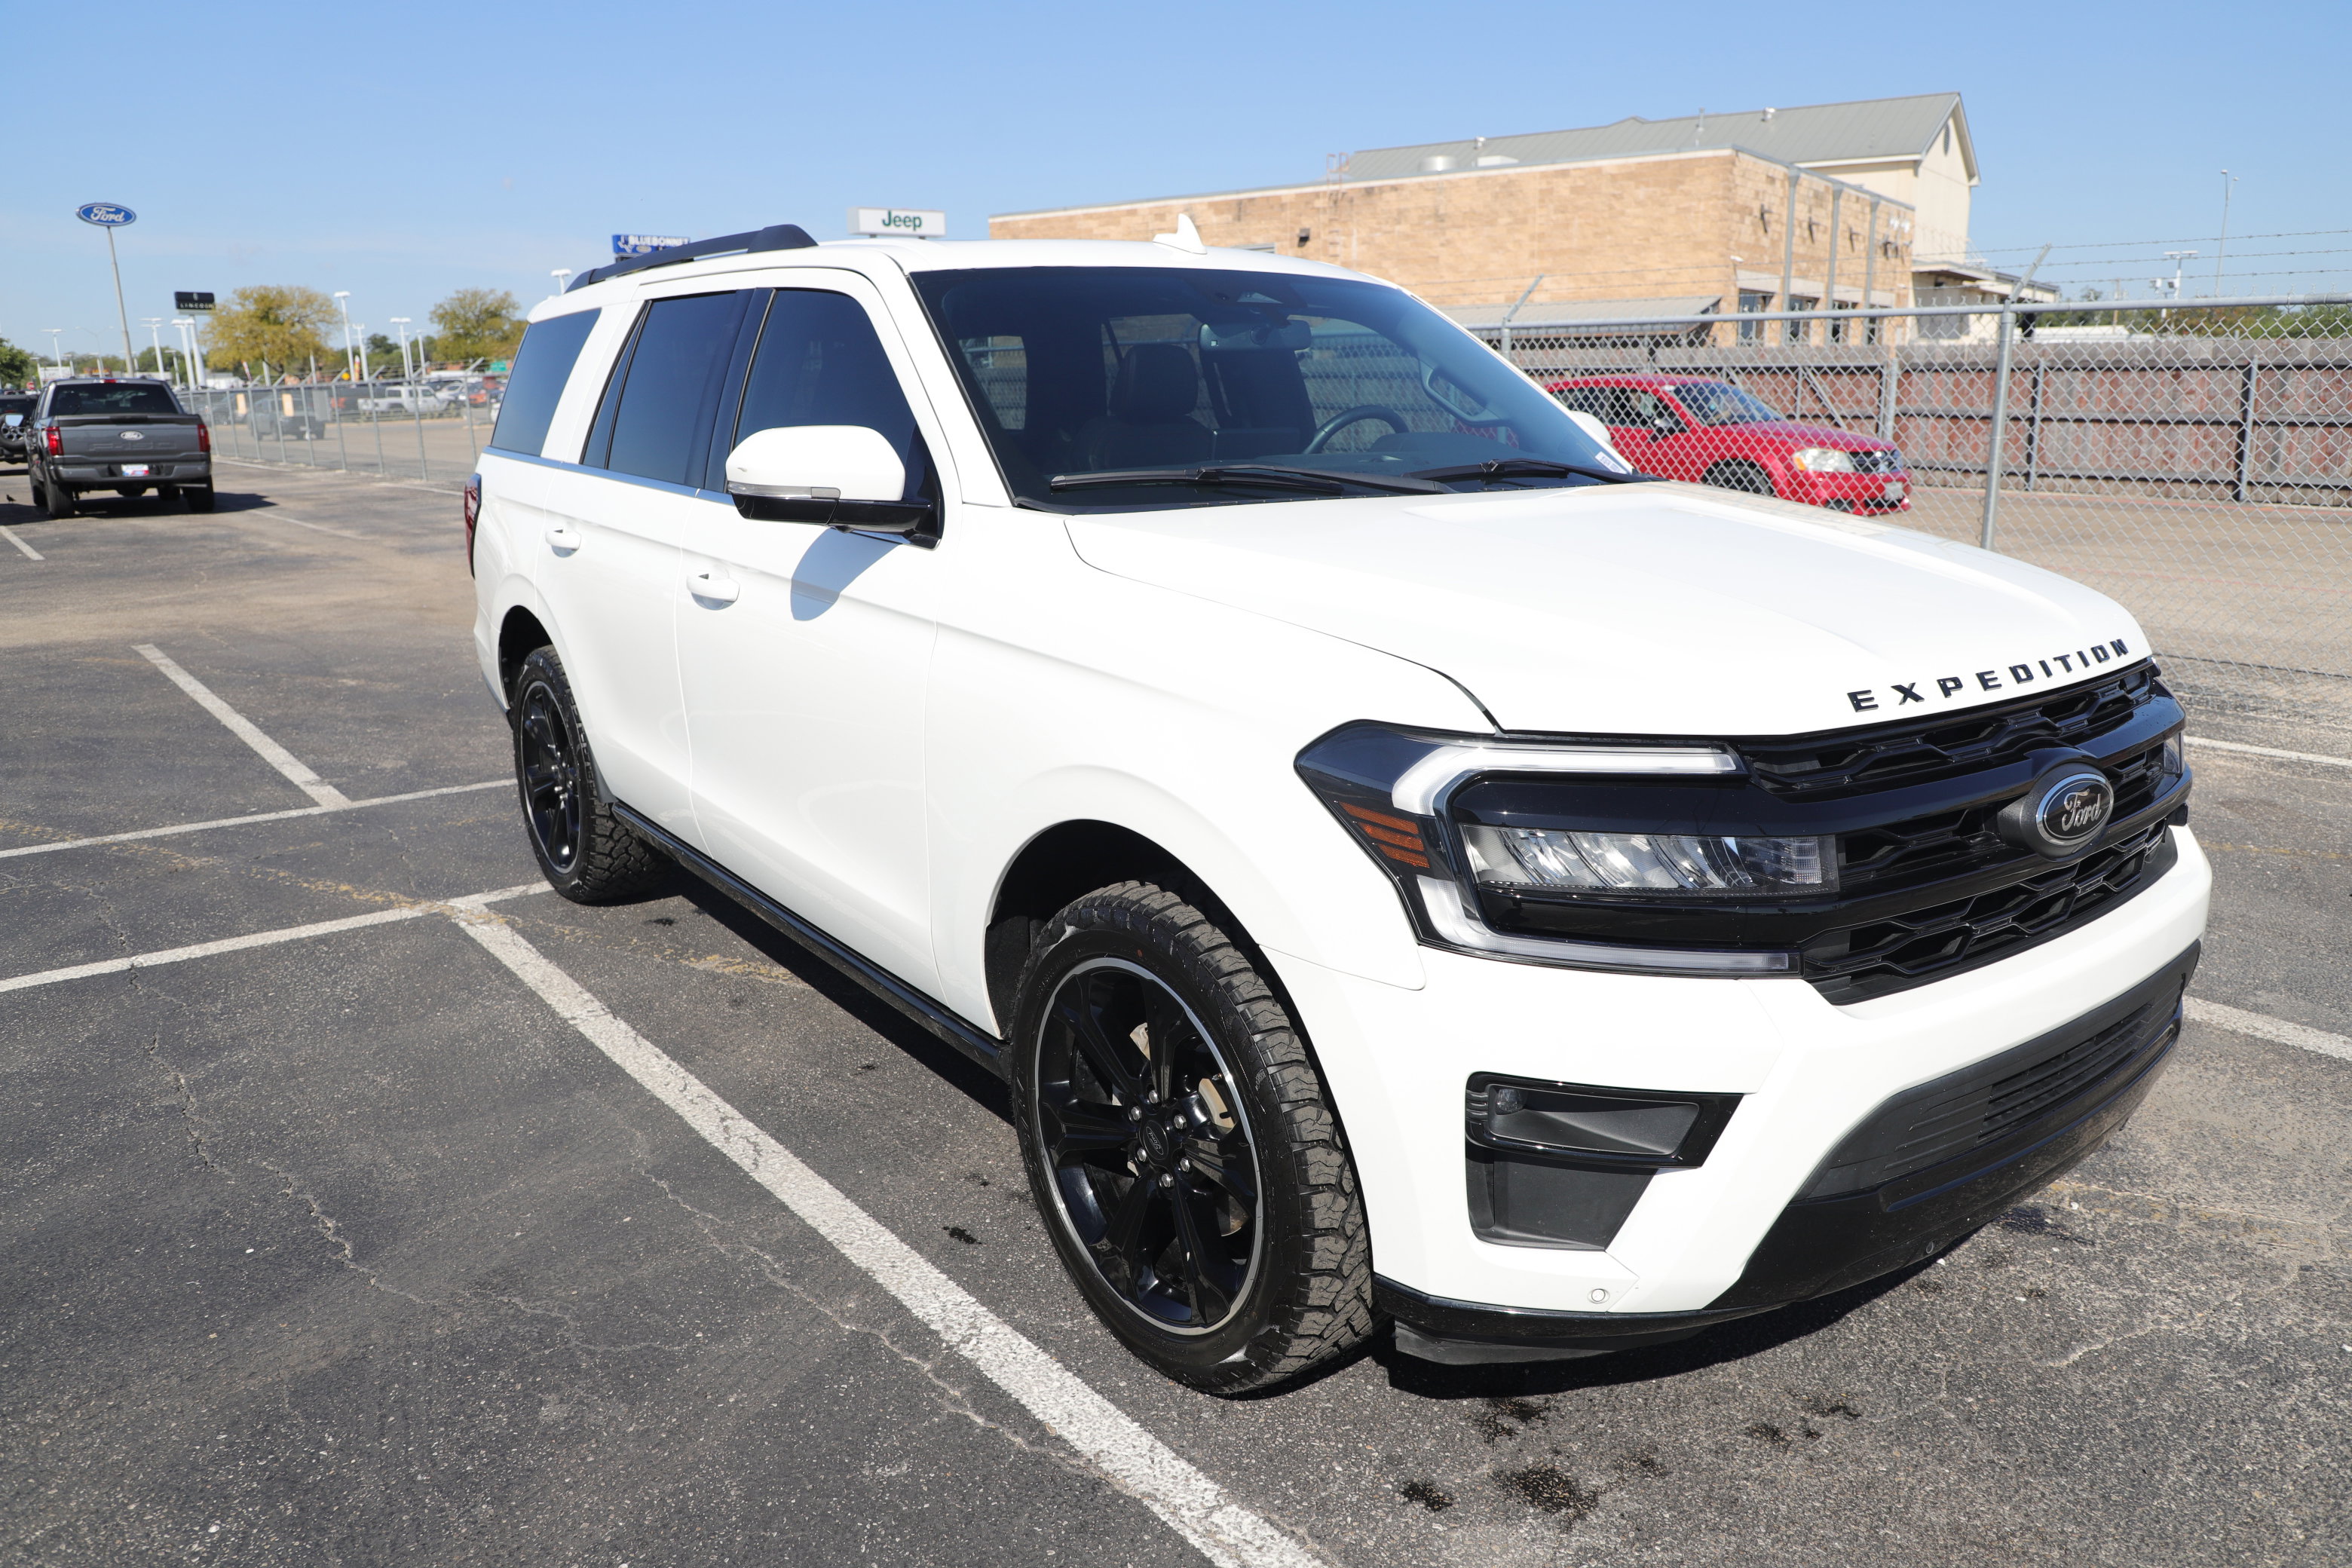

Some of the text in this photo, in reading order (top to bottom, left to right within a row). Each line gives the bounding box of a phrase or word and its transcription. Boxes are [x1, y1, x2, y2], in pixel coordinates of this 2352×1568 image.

[90, 206, 125, 222] Ford
[881, 210, 922, 231] Jeep
[1847, 639, 2129, 713] EXPEDITION
[2061, 789, 2101, 831] Ford
[1148, 1131, 1161, 1150] Ford
